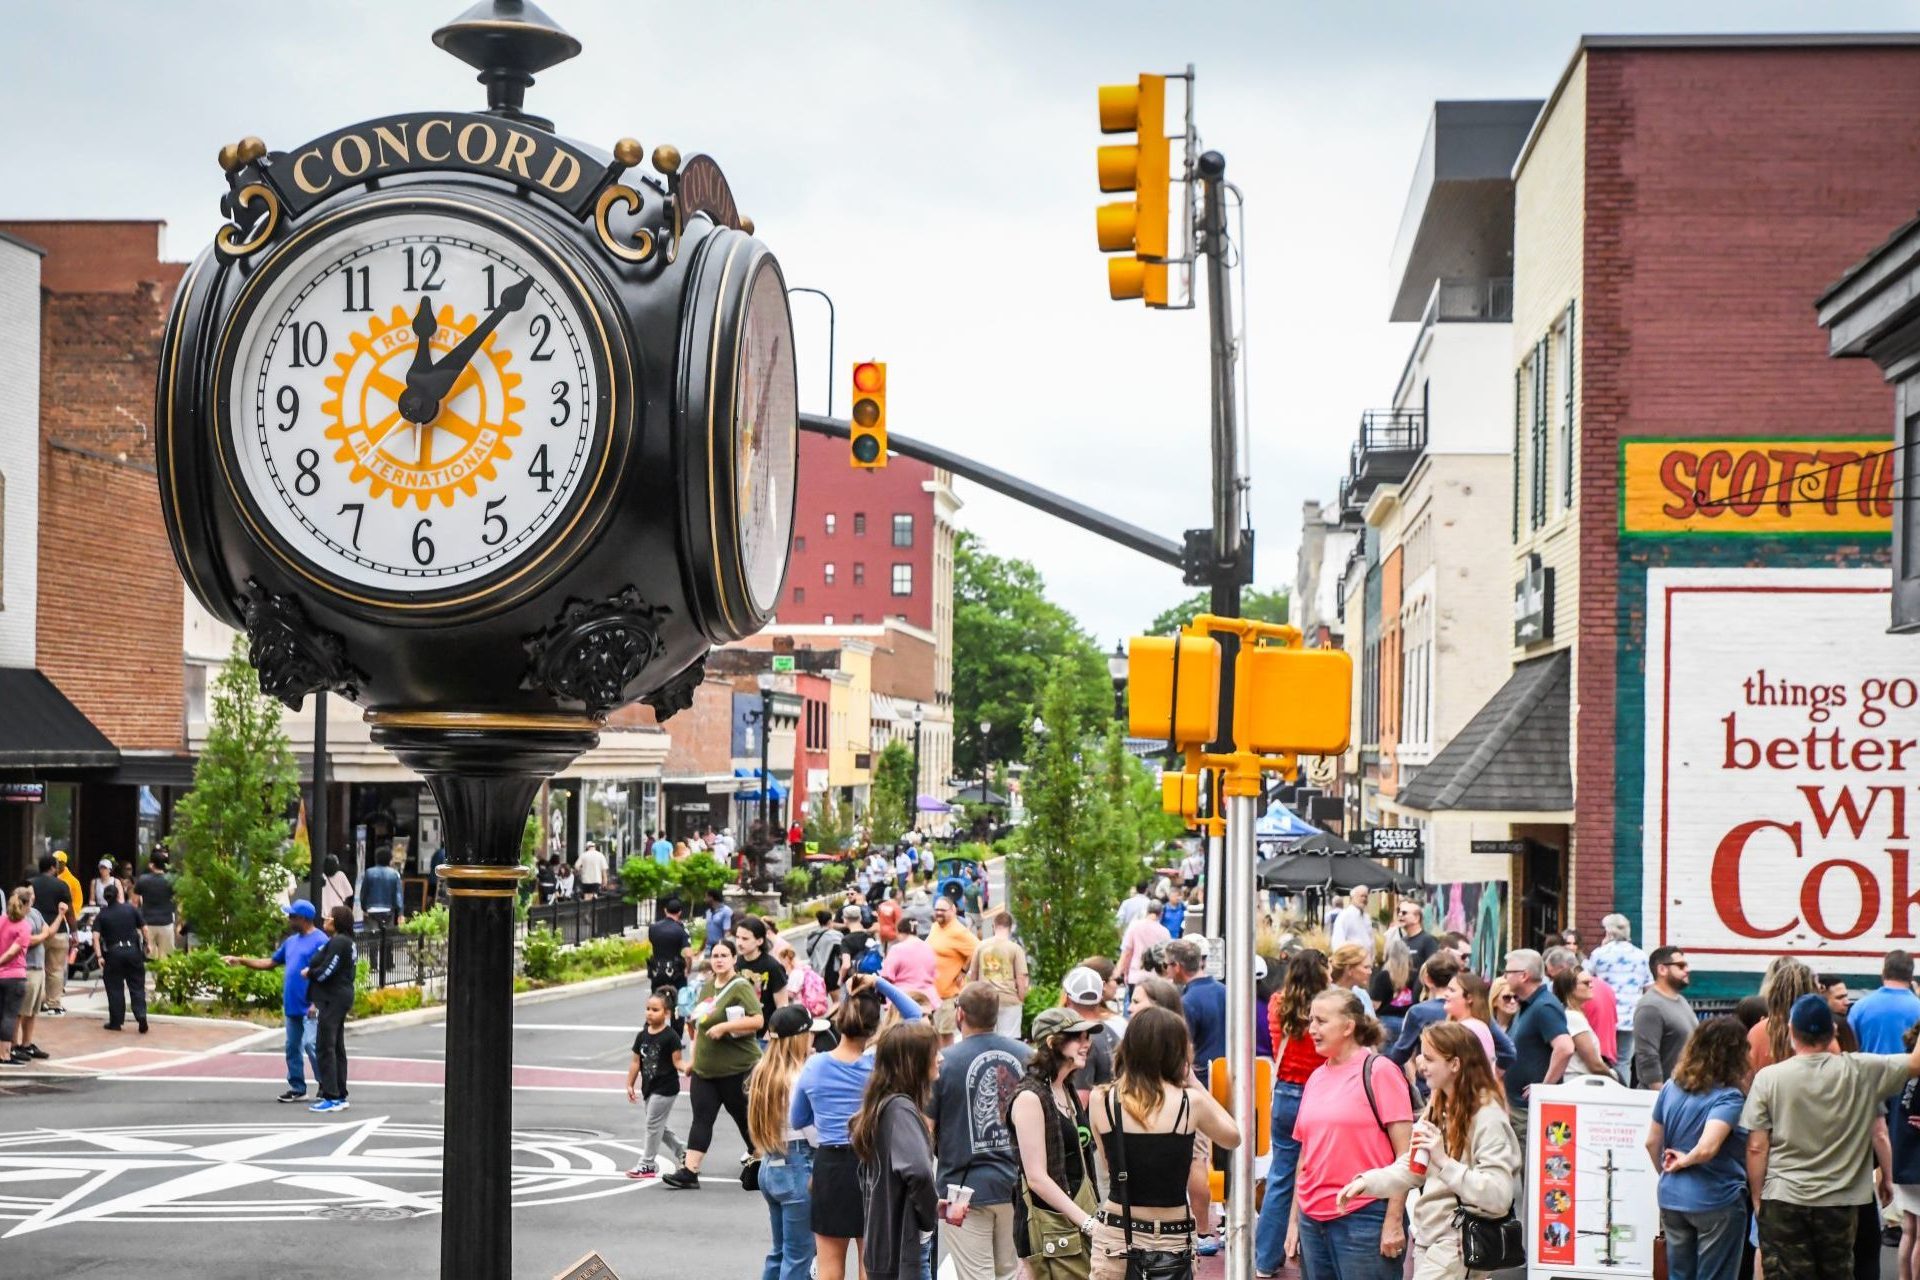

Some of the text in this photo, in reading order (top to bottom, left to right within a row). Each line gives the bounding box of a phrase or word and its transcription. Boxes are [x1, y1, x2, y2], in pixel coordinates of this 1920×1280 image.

[293, 119, 581, 194] CONCORD
[341, 265, 374, 313] 11
[402, 246, 445, 292] 12
[481, 264, 502, 313] 1
[288, 320, 328, 368] 10
[381, 328, 466, 351] RORY
[529, 314, 556, 362] 2
[276, 385, 300, 432] 9
[549, 380, 572, 427] 3
[294, 448, 321, 497] 8
[354, 434, 496, 488] INTERNATIONAL
[527, 443, 555, 493] 4
[337, 503, 365, 552] 7
[411, 518, 435, 566] 6
[481, 495, 508, 546] 5
[1742, 669, 1918, 728] things go
[1720, 711, 1917, 772] better
[1796, 785, 1920, 840] wi
[1373, 838, 1418, 849] PORTER
